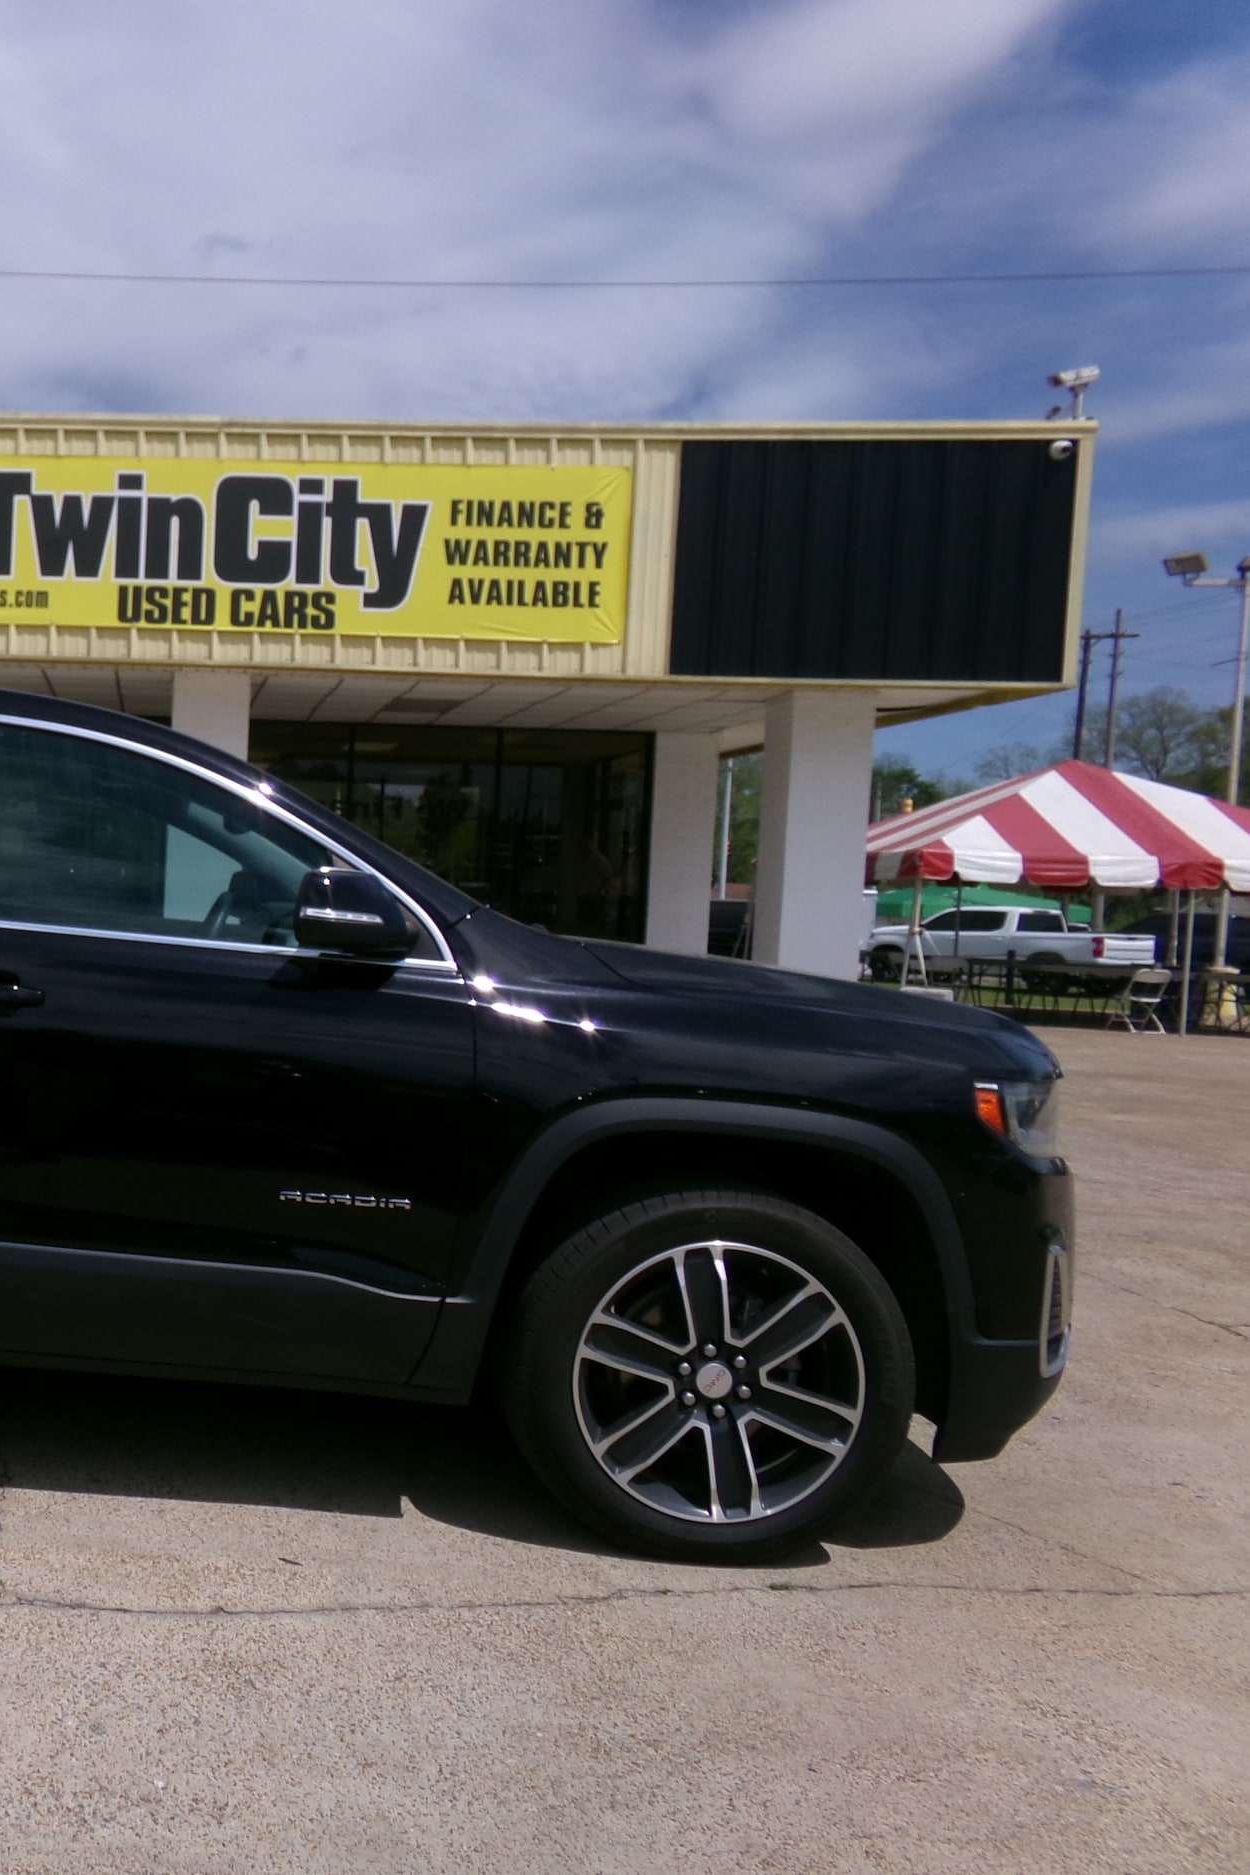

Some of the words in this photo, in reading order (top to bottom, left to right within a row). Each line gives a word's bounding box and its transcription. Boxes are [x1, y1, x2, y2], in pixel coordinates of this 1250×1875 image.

[450, 499, 572, 529] FINANCE
[584, 502, 604, 530] &
[444, 538, 608, 569] WARRANTY
[117, 585, 216, 626] USED
[230, 588, 336, 630] CARS
[447, 578, 602, 608] AVAILABLE
[279, 1190, 412, 1210] ACADIA
